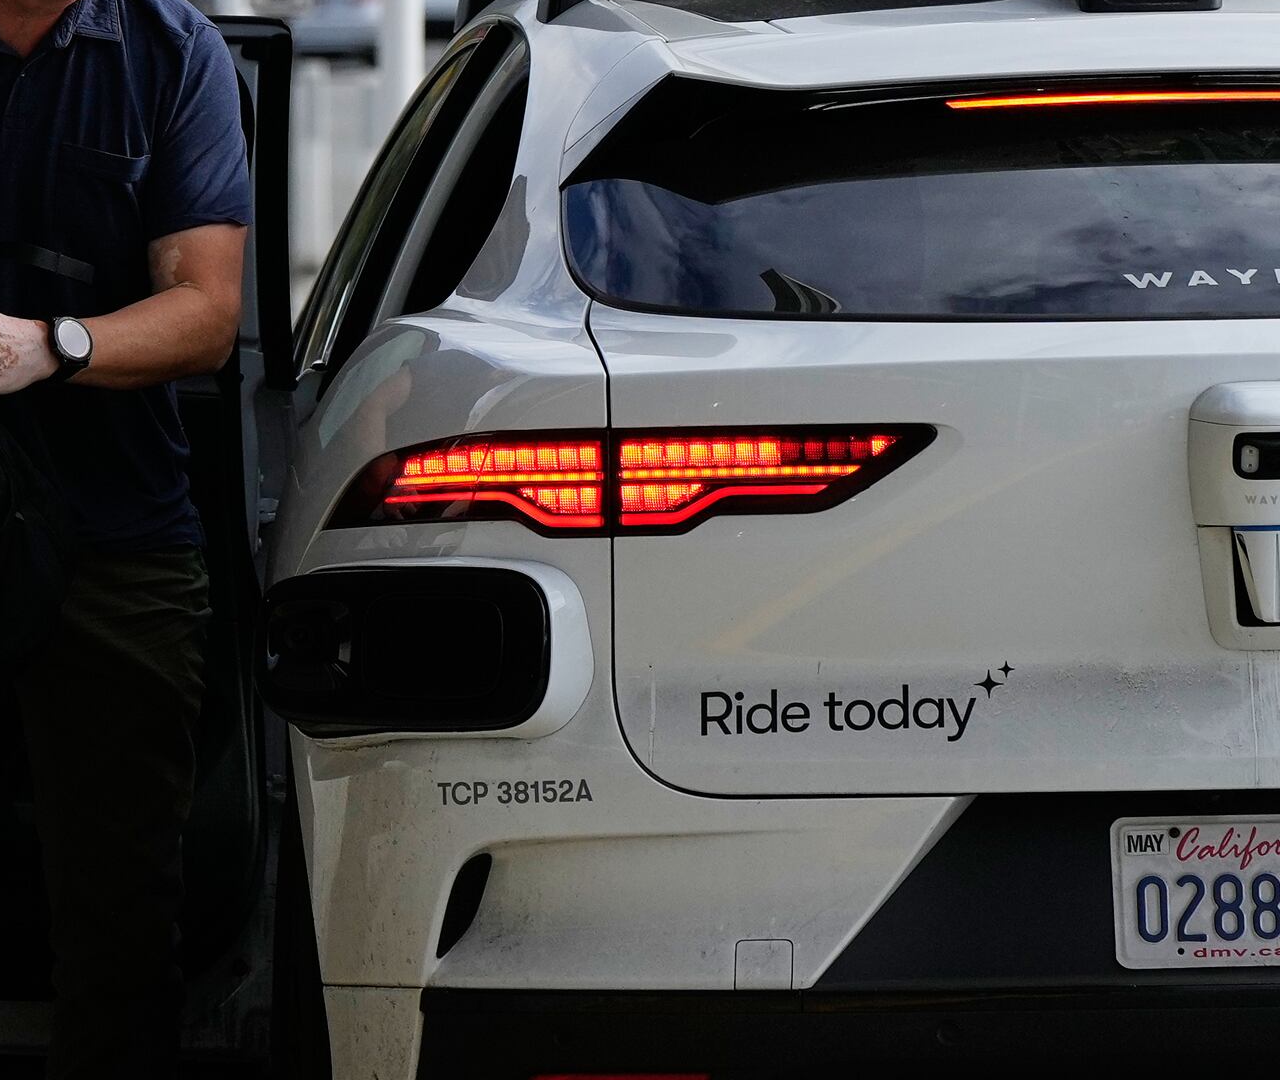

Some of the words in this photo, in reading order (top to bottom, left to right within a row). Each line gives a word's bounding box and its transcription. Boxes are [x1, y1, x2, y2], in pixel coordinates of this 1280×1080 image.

[700, 688, 811, 736] Ride
[823, 683, 977, 742] today
[437, 781, 489, 806] TCP
[497, 779, 593, 805] 38152A
[1127, 833, 1164, 853] MAY
